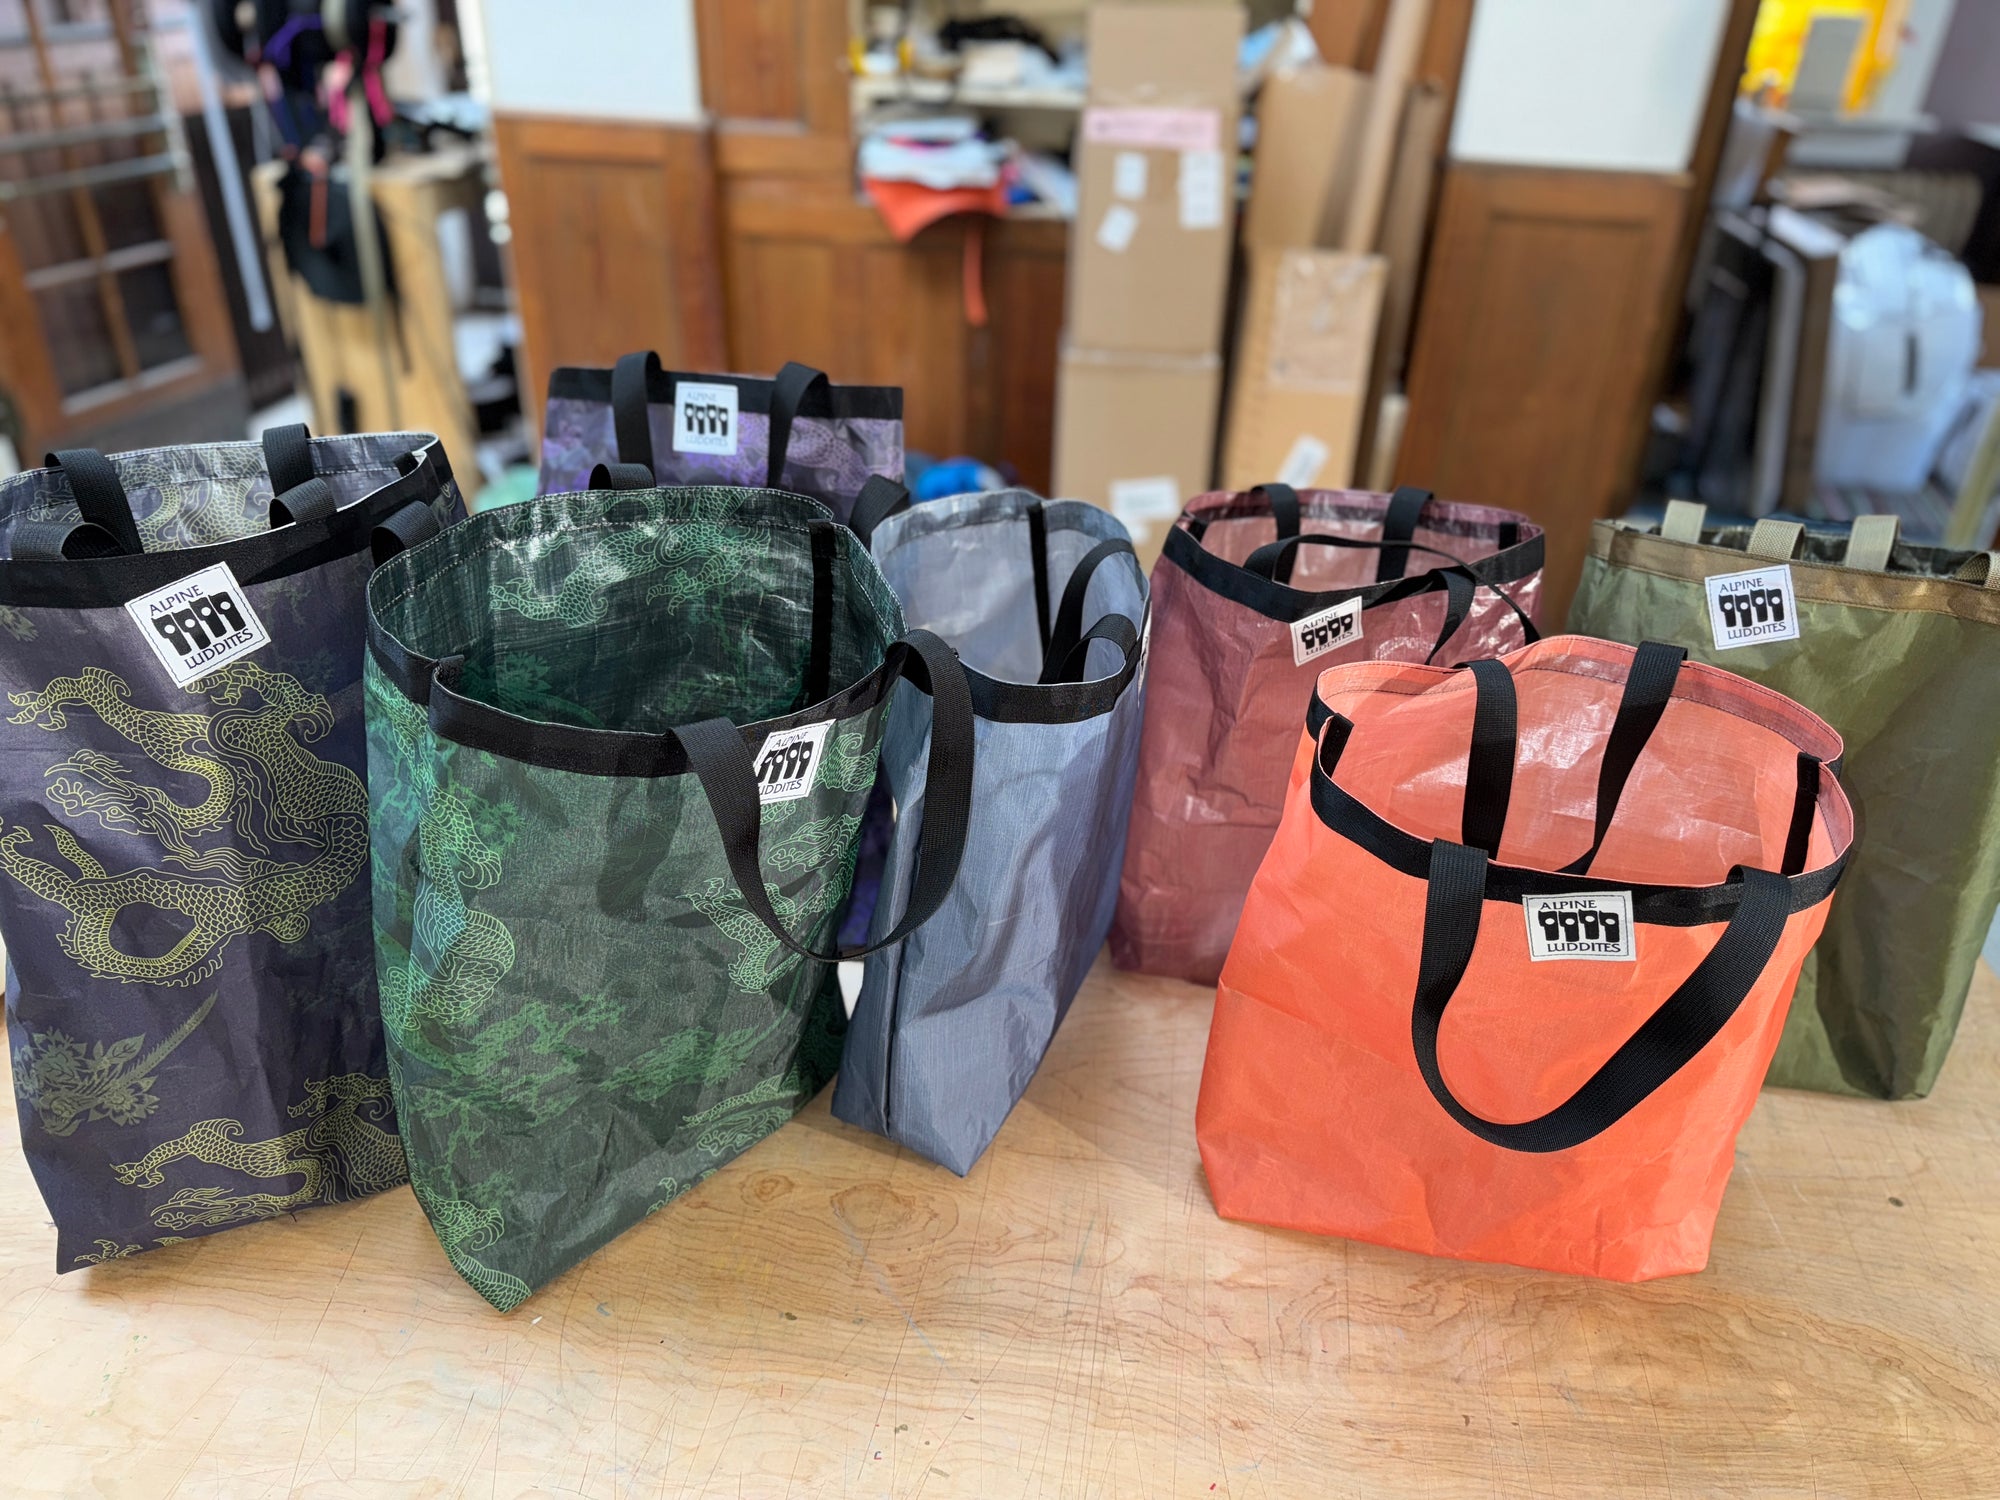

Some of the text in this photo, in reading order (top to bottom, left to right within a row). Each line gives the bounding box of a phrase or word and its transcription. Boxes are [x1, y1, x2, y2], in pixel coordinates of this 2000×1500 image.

[1719, 578, 1764, 593] ALPINE
[150, 585, 203, 616] ALPINE
[1302, 612, 1338, 631] ALPINE
[1727, 622, 1787, 639] LUDDITES
[184, 628, 253, 669] LUDDITES
[1306, 631, 1353, 656] LUDDITES
[772, 731, 808, 749] ALPINE
[1540, 900, 1597, 910] ALPINE
[1547, 942, 1621, 953] LUDDITES
